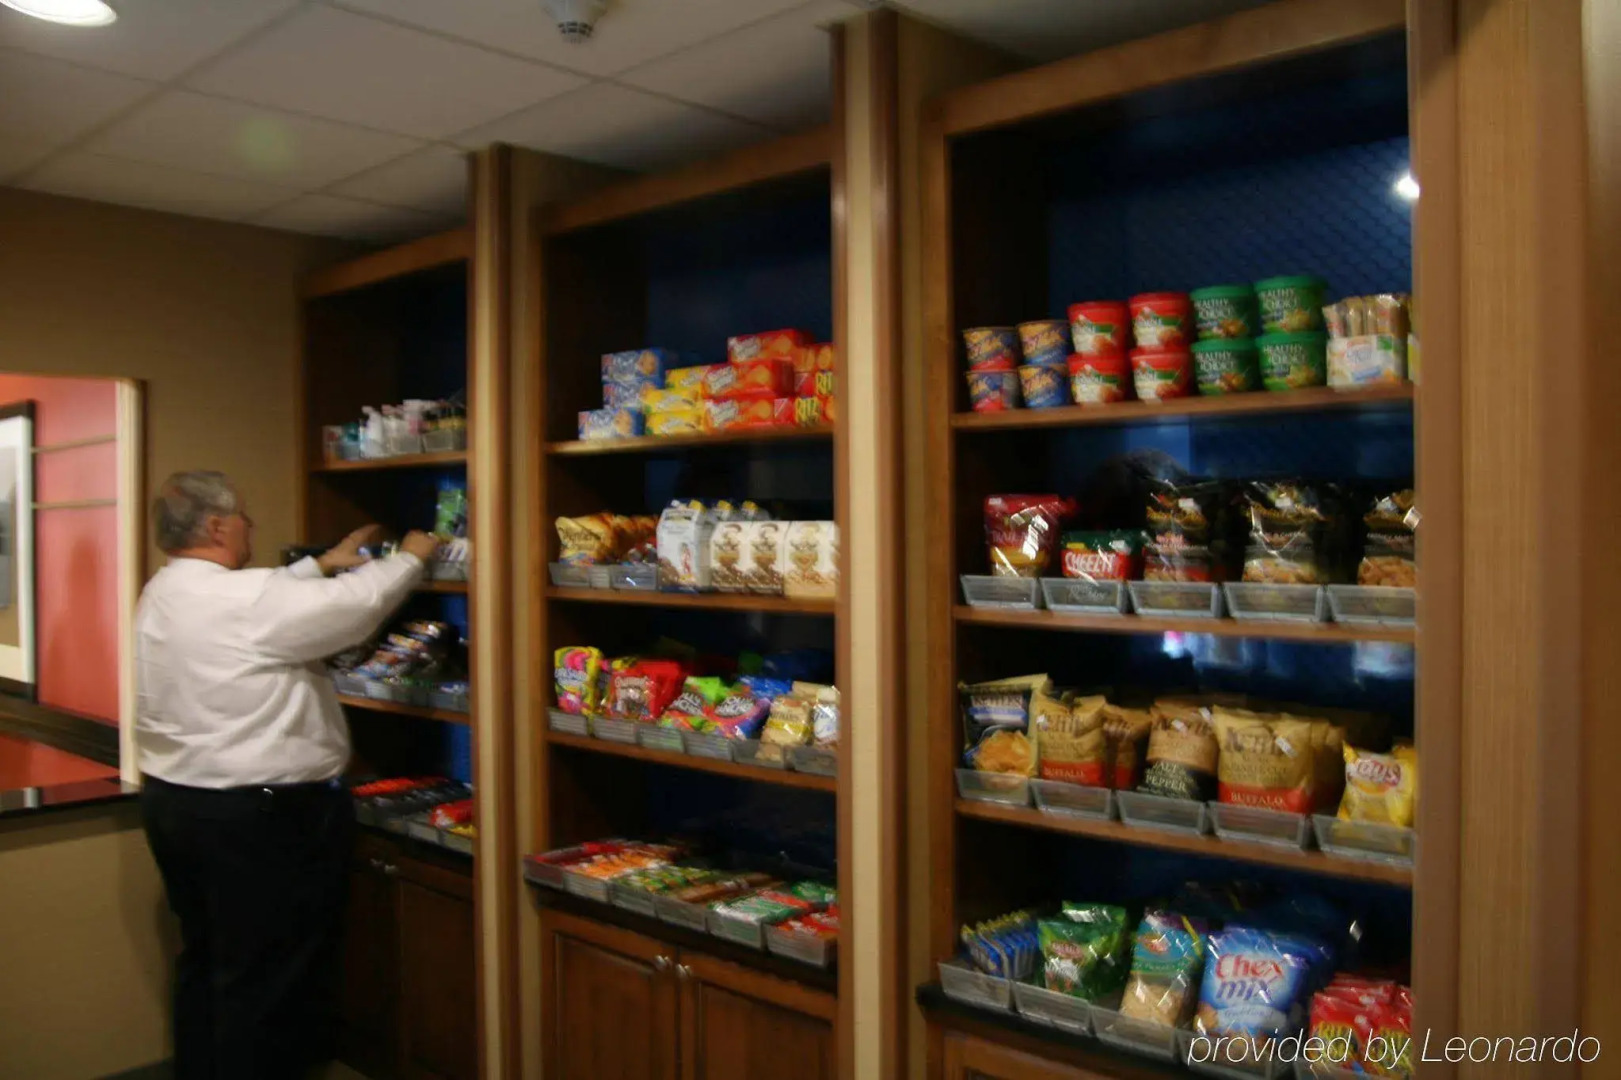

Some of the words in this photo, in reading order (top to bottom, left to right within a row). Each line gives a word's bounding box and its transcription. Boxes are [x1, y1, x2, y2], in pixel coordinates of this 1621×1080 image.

[816, 371, 834, 396] RIT
[796, 397, 821, 425] RITZ
[1144, 774, 1187, 792] PEPPER
[1215, 952, 1284, 980] Chex
[1215, 976, 1276, 1002] mix
